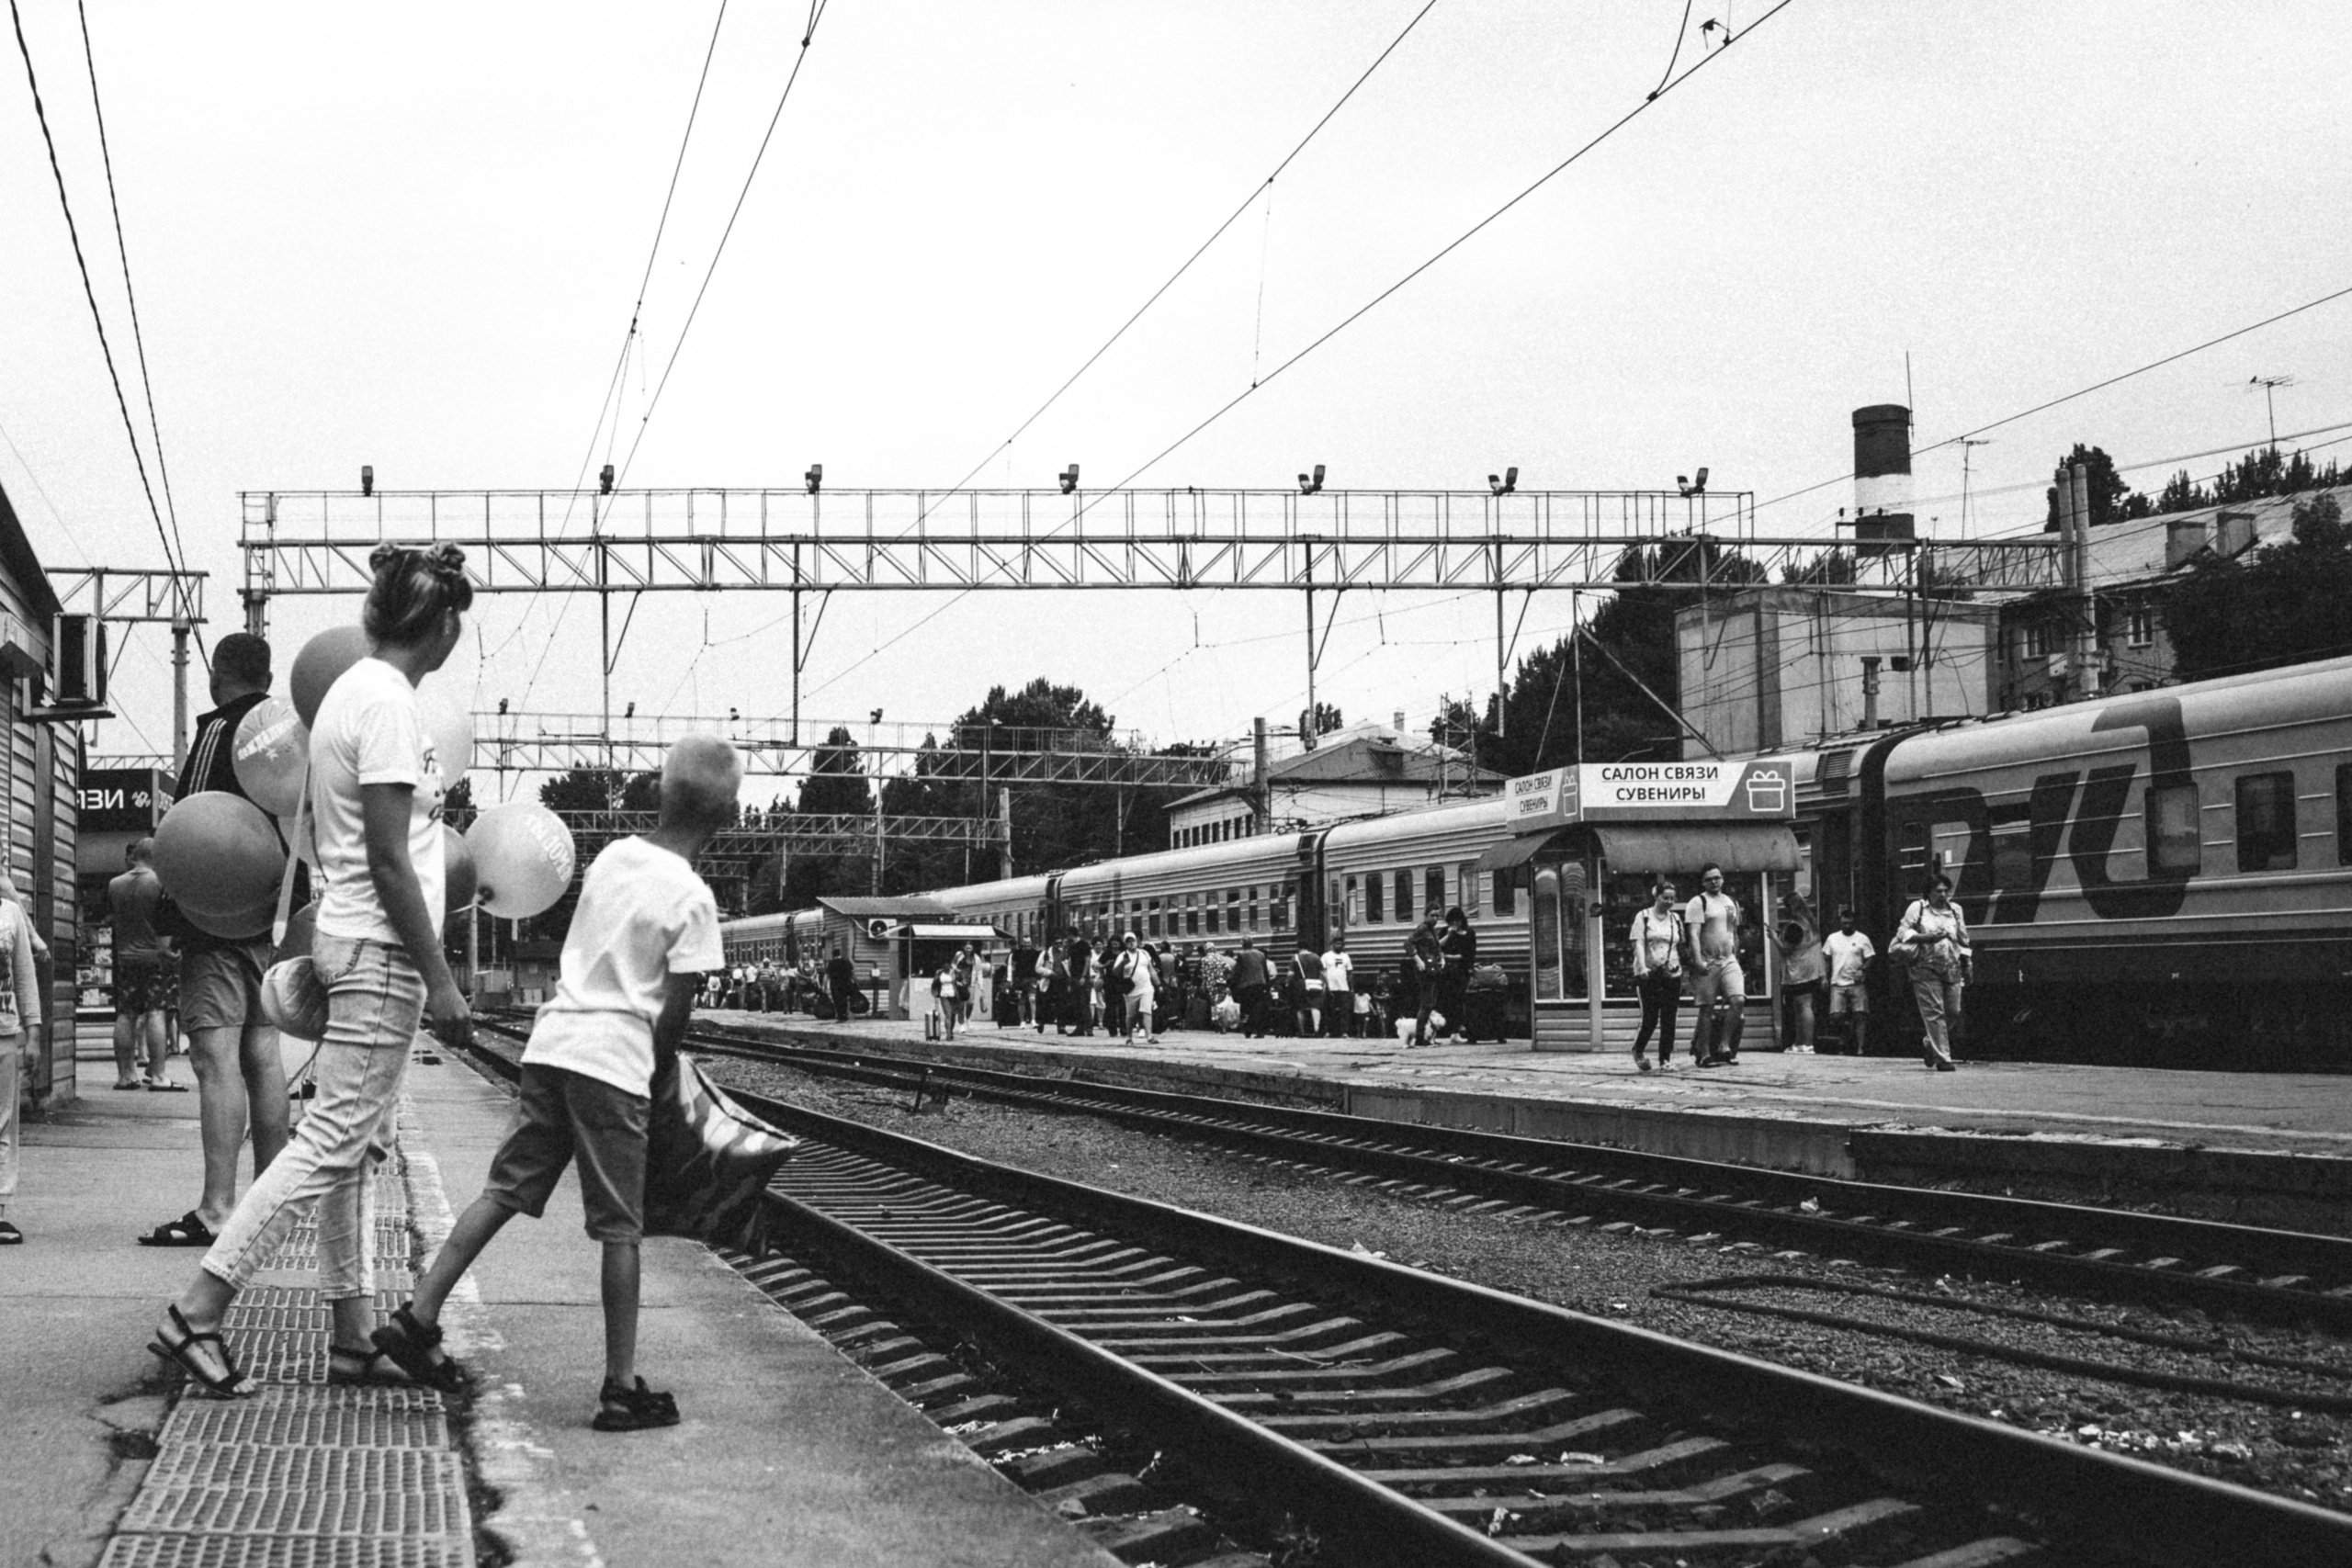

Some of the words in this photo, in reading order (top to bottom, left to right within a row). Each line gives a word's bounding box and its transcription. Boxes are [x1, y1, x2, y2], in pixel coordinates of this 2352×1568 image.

[1601, 766, 1659, 781] САЛОН
[1664, 766, 1718, 780] СВЯЗИ
[1615, 786, 1705, 801] СУВЕНИРЫ
